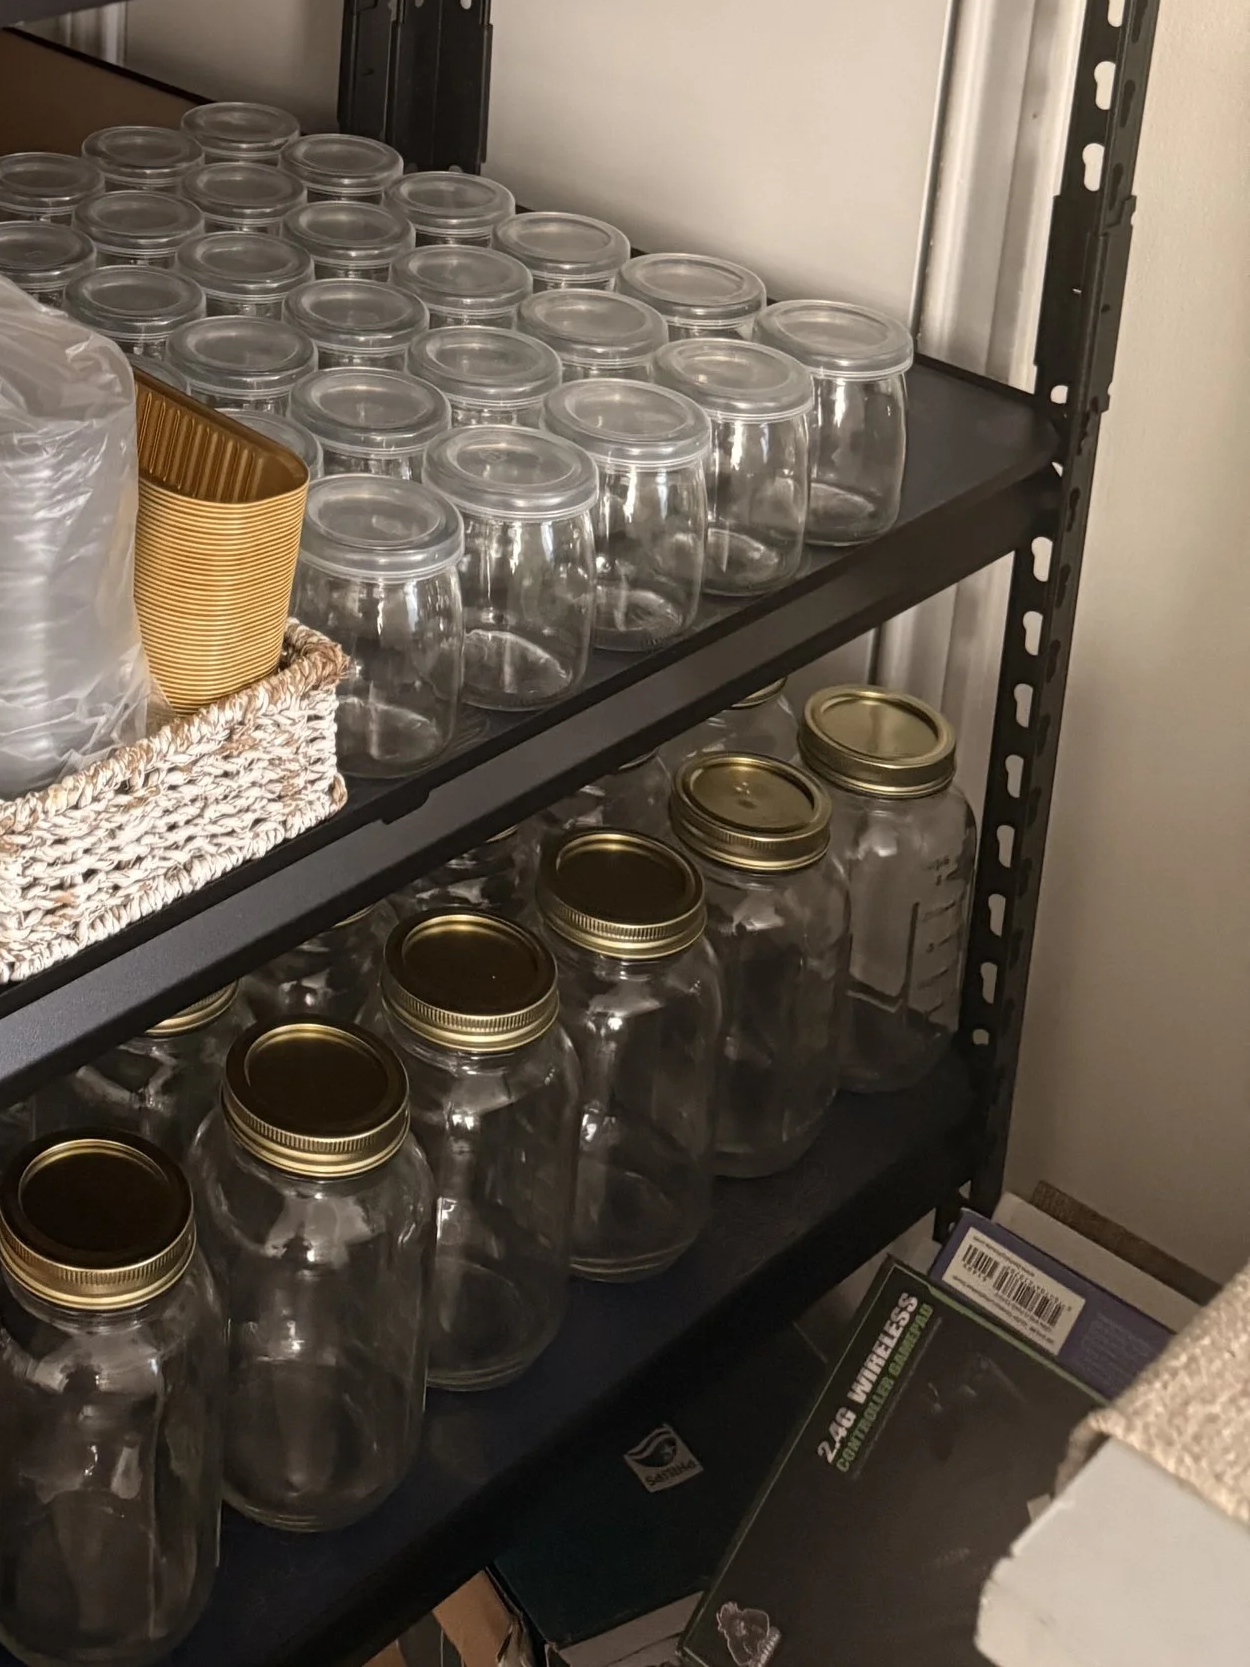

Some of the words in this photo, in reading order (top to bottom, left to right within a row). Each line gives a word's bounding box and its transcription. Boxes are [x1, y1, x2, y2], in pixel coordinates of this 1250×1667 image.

[817, 1406, 857, 1464] 2.4G
[847, 1292, 918, 1404] WIRELESS
[836, 1376, 895, 1472] CONTROLLER
[888, 1302, 933, 1376] GAMEPAD
